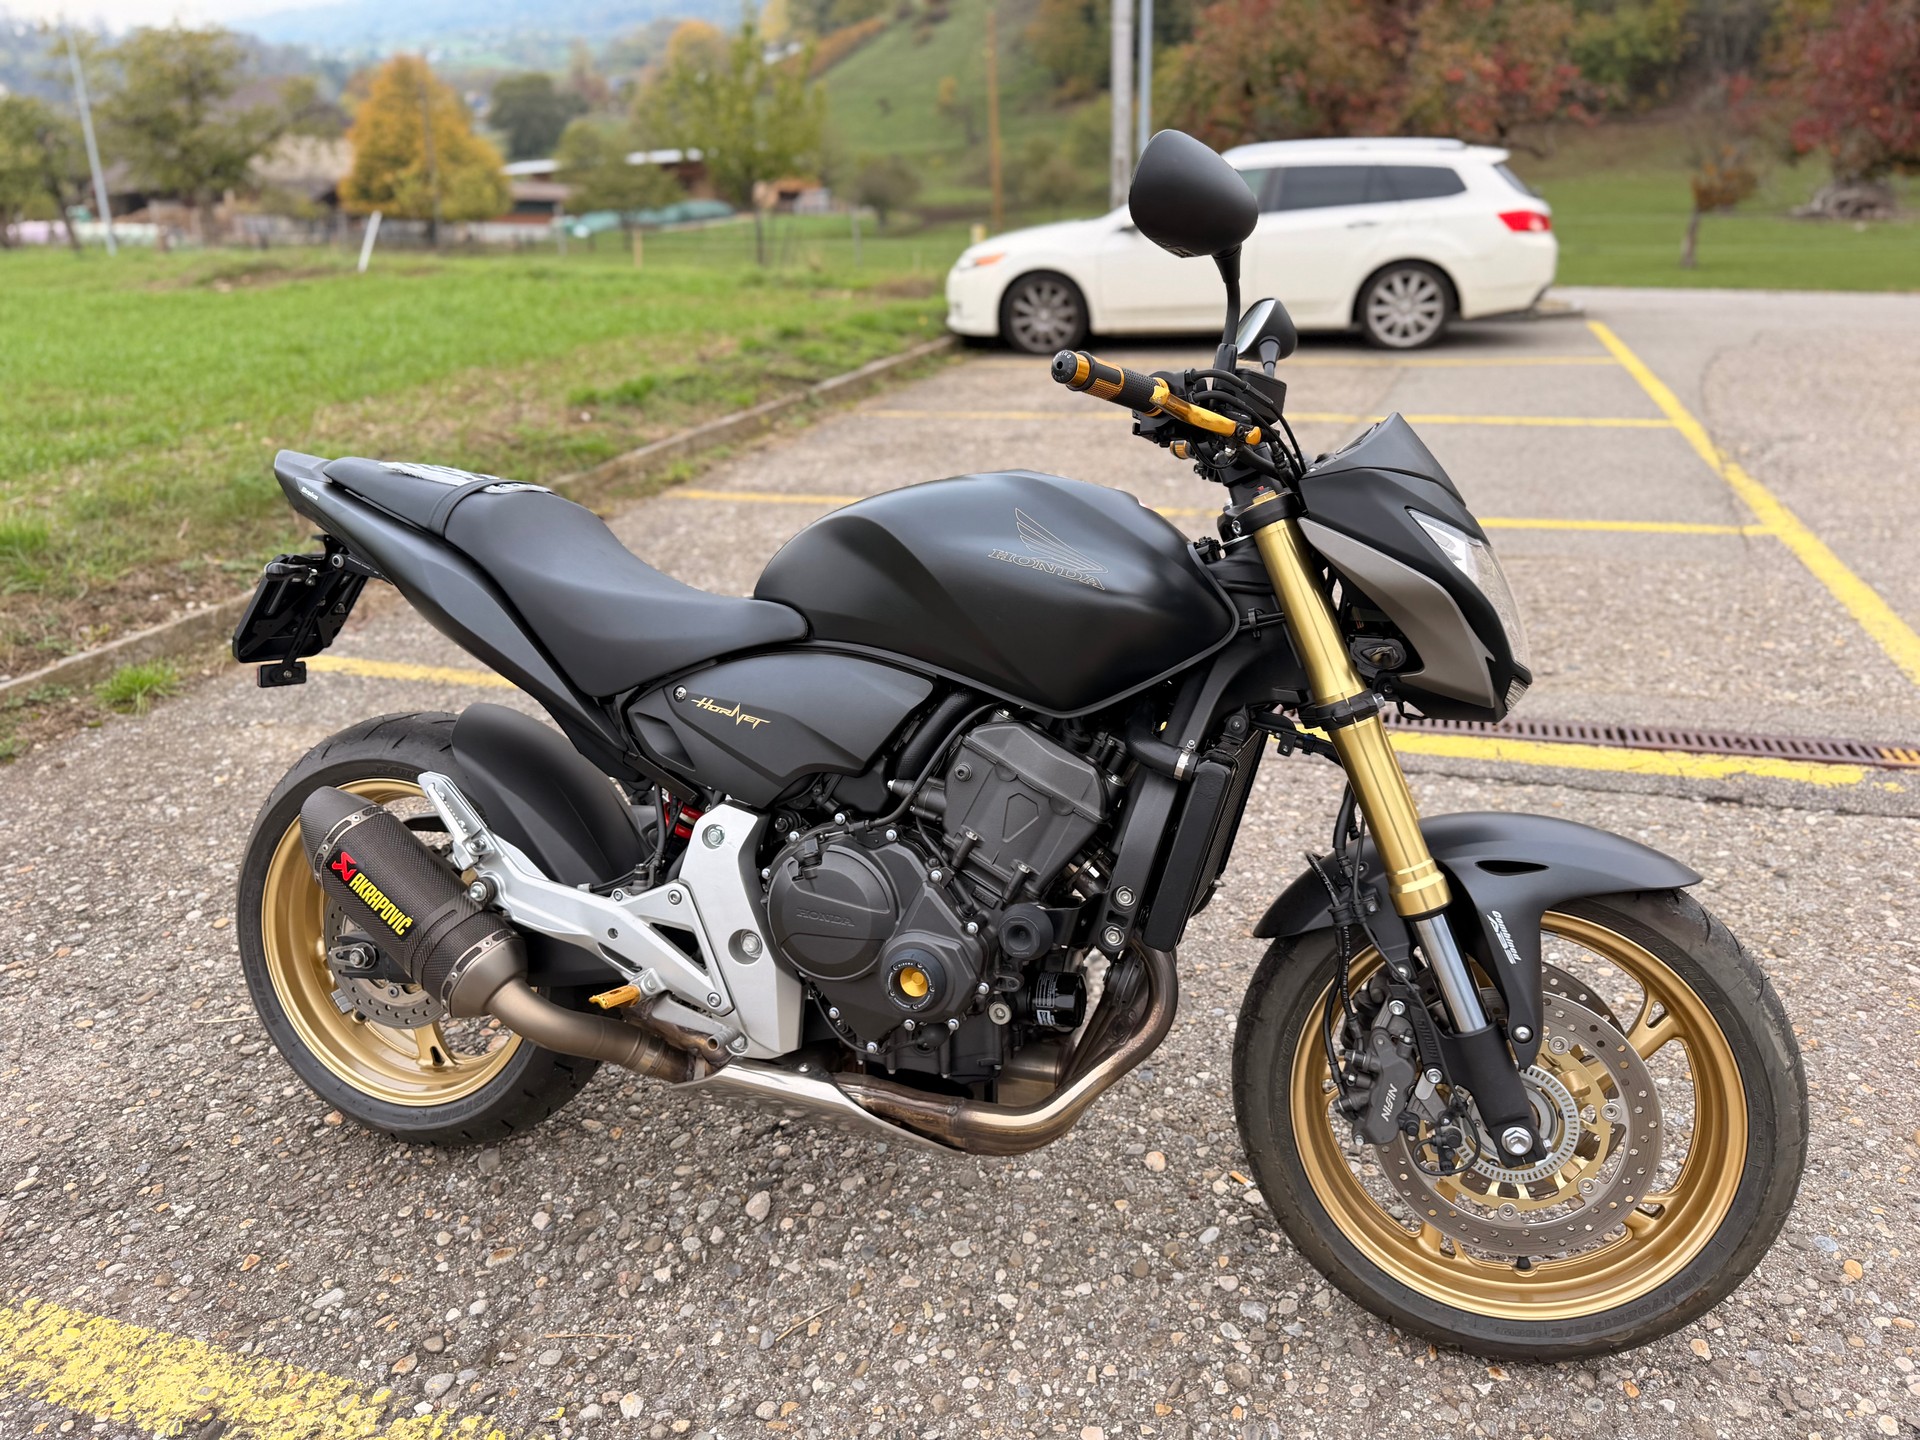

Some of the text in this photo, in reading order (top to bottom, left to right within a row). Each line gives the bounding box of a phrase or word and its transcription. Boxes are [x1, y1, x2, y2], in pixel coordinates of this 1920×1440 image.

[988, 549, 1105, 590] HONDA
[1492, 910, 1522, 961] Combined
[1381, 1083, 1398, 1122] NISSIN
